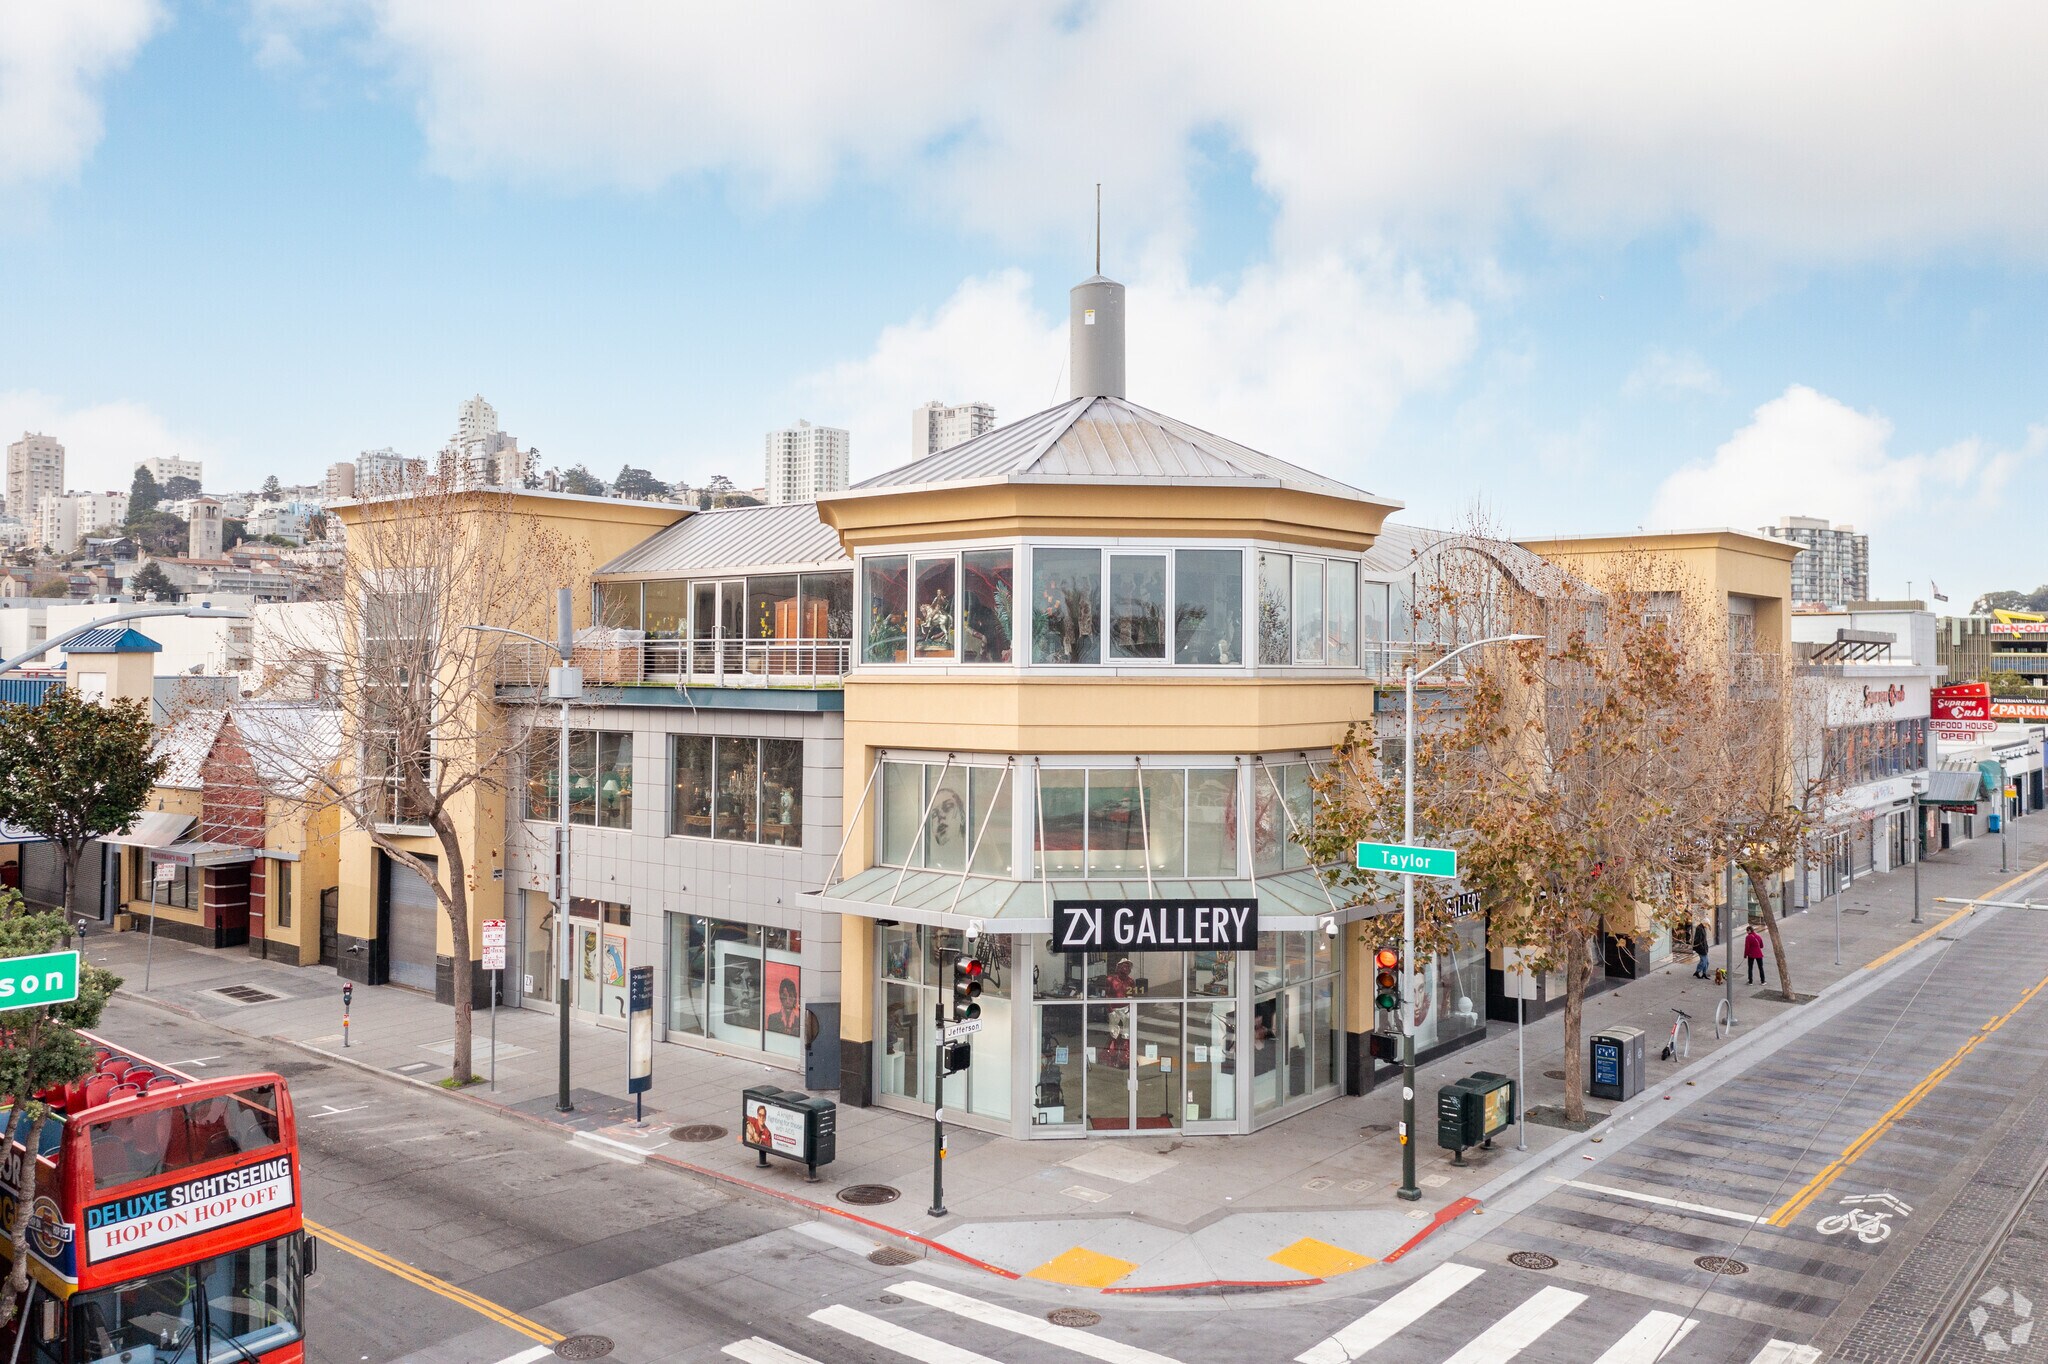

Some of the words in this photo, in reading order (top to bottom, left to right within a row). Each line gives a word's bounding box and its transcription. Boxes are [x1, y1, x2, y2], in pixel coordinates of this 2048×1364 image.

[1930, 721, 1963, 729] EAFOOD
[1965, 722, 1993, 730] HOUSE
[1941, 732, 1972, 740] OPEN
[1381, 850, 1431, 869] Taylor
[1113, 907, 1250, 945] GALLERY
[1126, 986, 1145, 995] 211
[948, 1023, 980, 1036] Jefferson
[88, 1191, 168, 1229] DELUXE
[171, 1157, 290, 1207] SIGHTSEEING
[105, 1221, 153, 1248] HOP
[158, 1210, 188, 1232] ON
[195, 1197, 237, 1223] HOP
[241, 1184, 279, 1208] OFF
